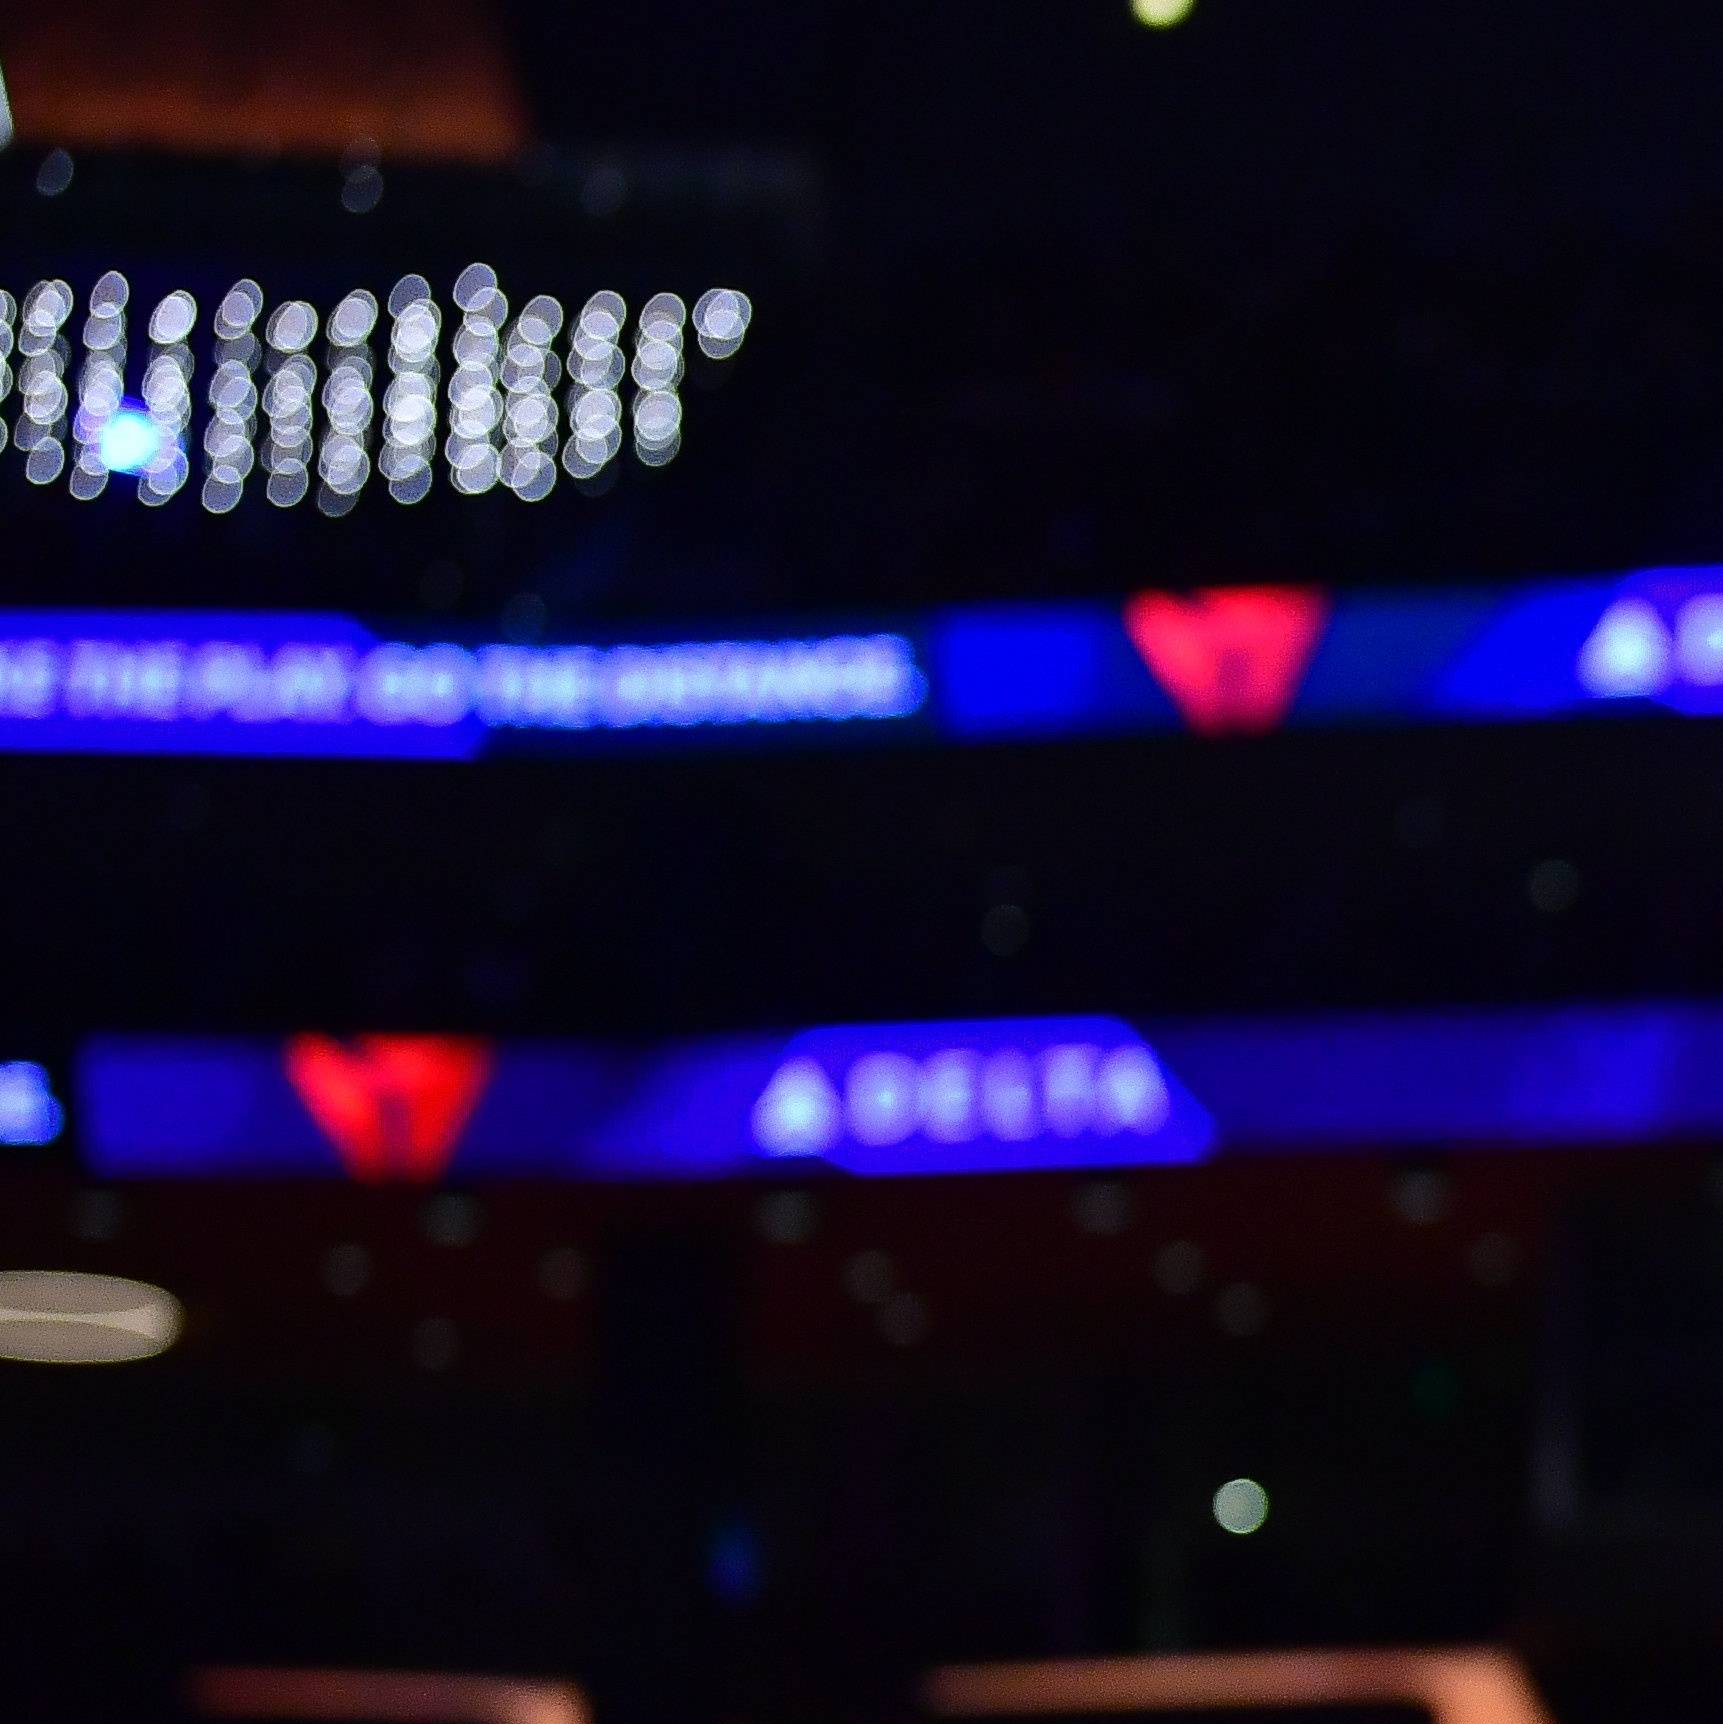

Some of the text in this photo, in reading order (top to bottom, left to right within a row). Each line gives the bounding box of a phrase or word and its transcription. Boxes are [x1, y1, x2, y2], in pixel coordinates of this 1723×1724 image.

[66, 640, 182, 720] THE
[356, 642, 474, 726] GO
[845, 1042, 1168, 1146] DELTA
